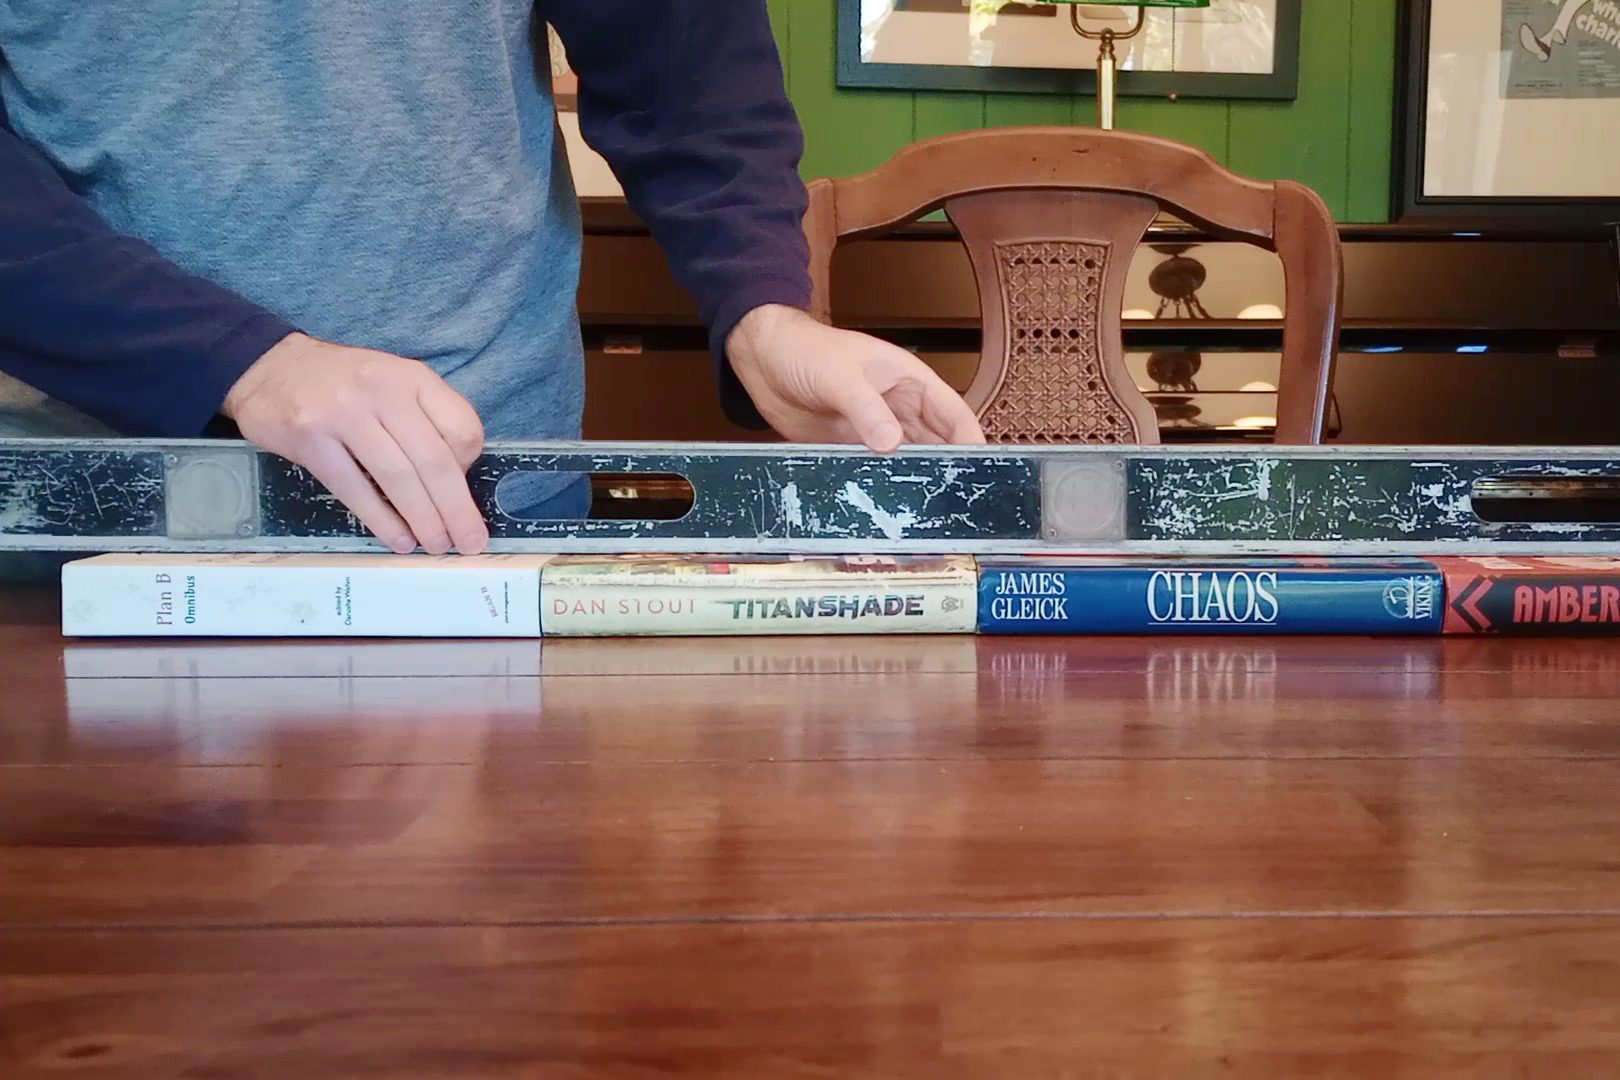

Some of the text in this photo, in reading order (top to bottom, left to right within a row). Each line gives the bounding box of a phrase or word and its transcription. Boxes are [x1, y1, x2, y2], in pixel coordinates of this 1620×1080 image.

[156, 573, 172, 625] Plan B
[184, 575, 196, 624] Omnibus
[995, 573, 1065, 595] JAMES
[1147, 570, 1279, 622] CHAOS
[1415, 575, 1433, 619] VIKING
[554, 599, 697, 615] DAN STOUT
[713, 594, 925, 619] TITANSHADE
[991, 598, 1069, 620] GLEICK
[1513, 585, 1620, 623] AMBER
